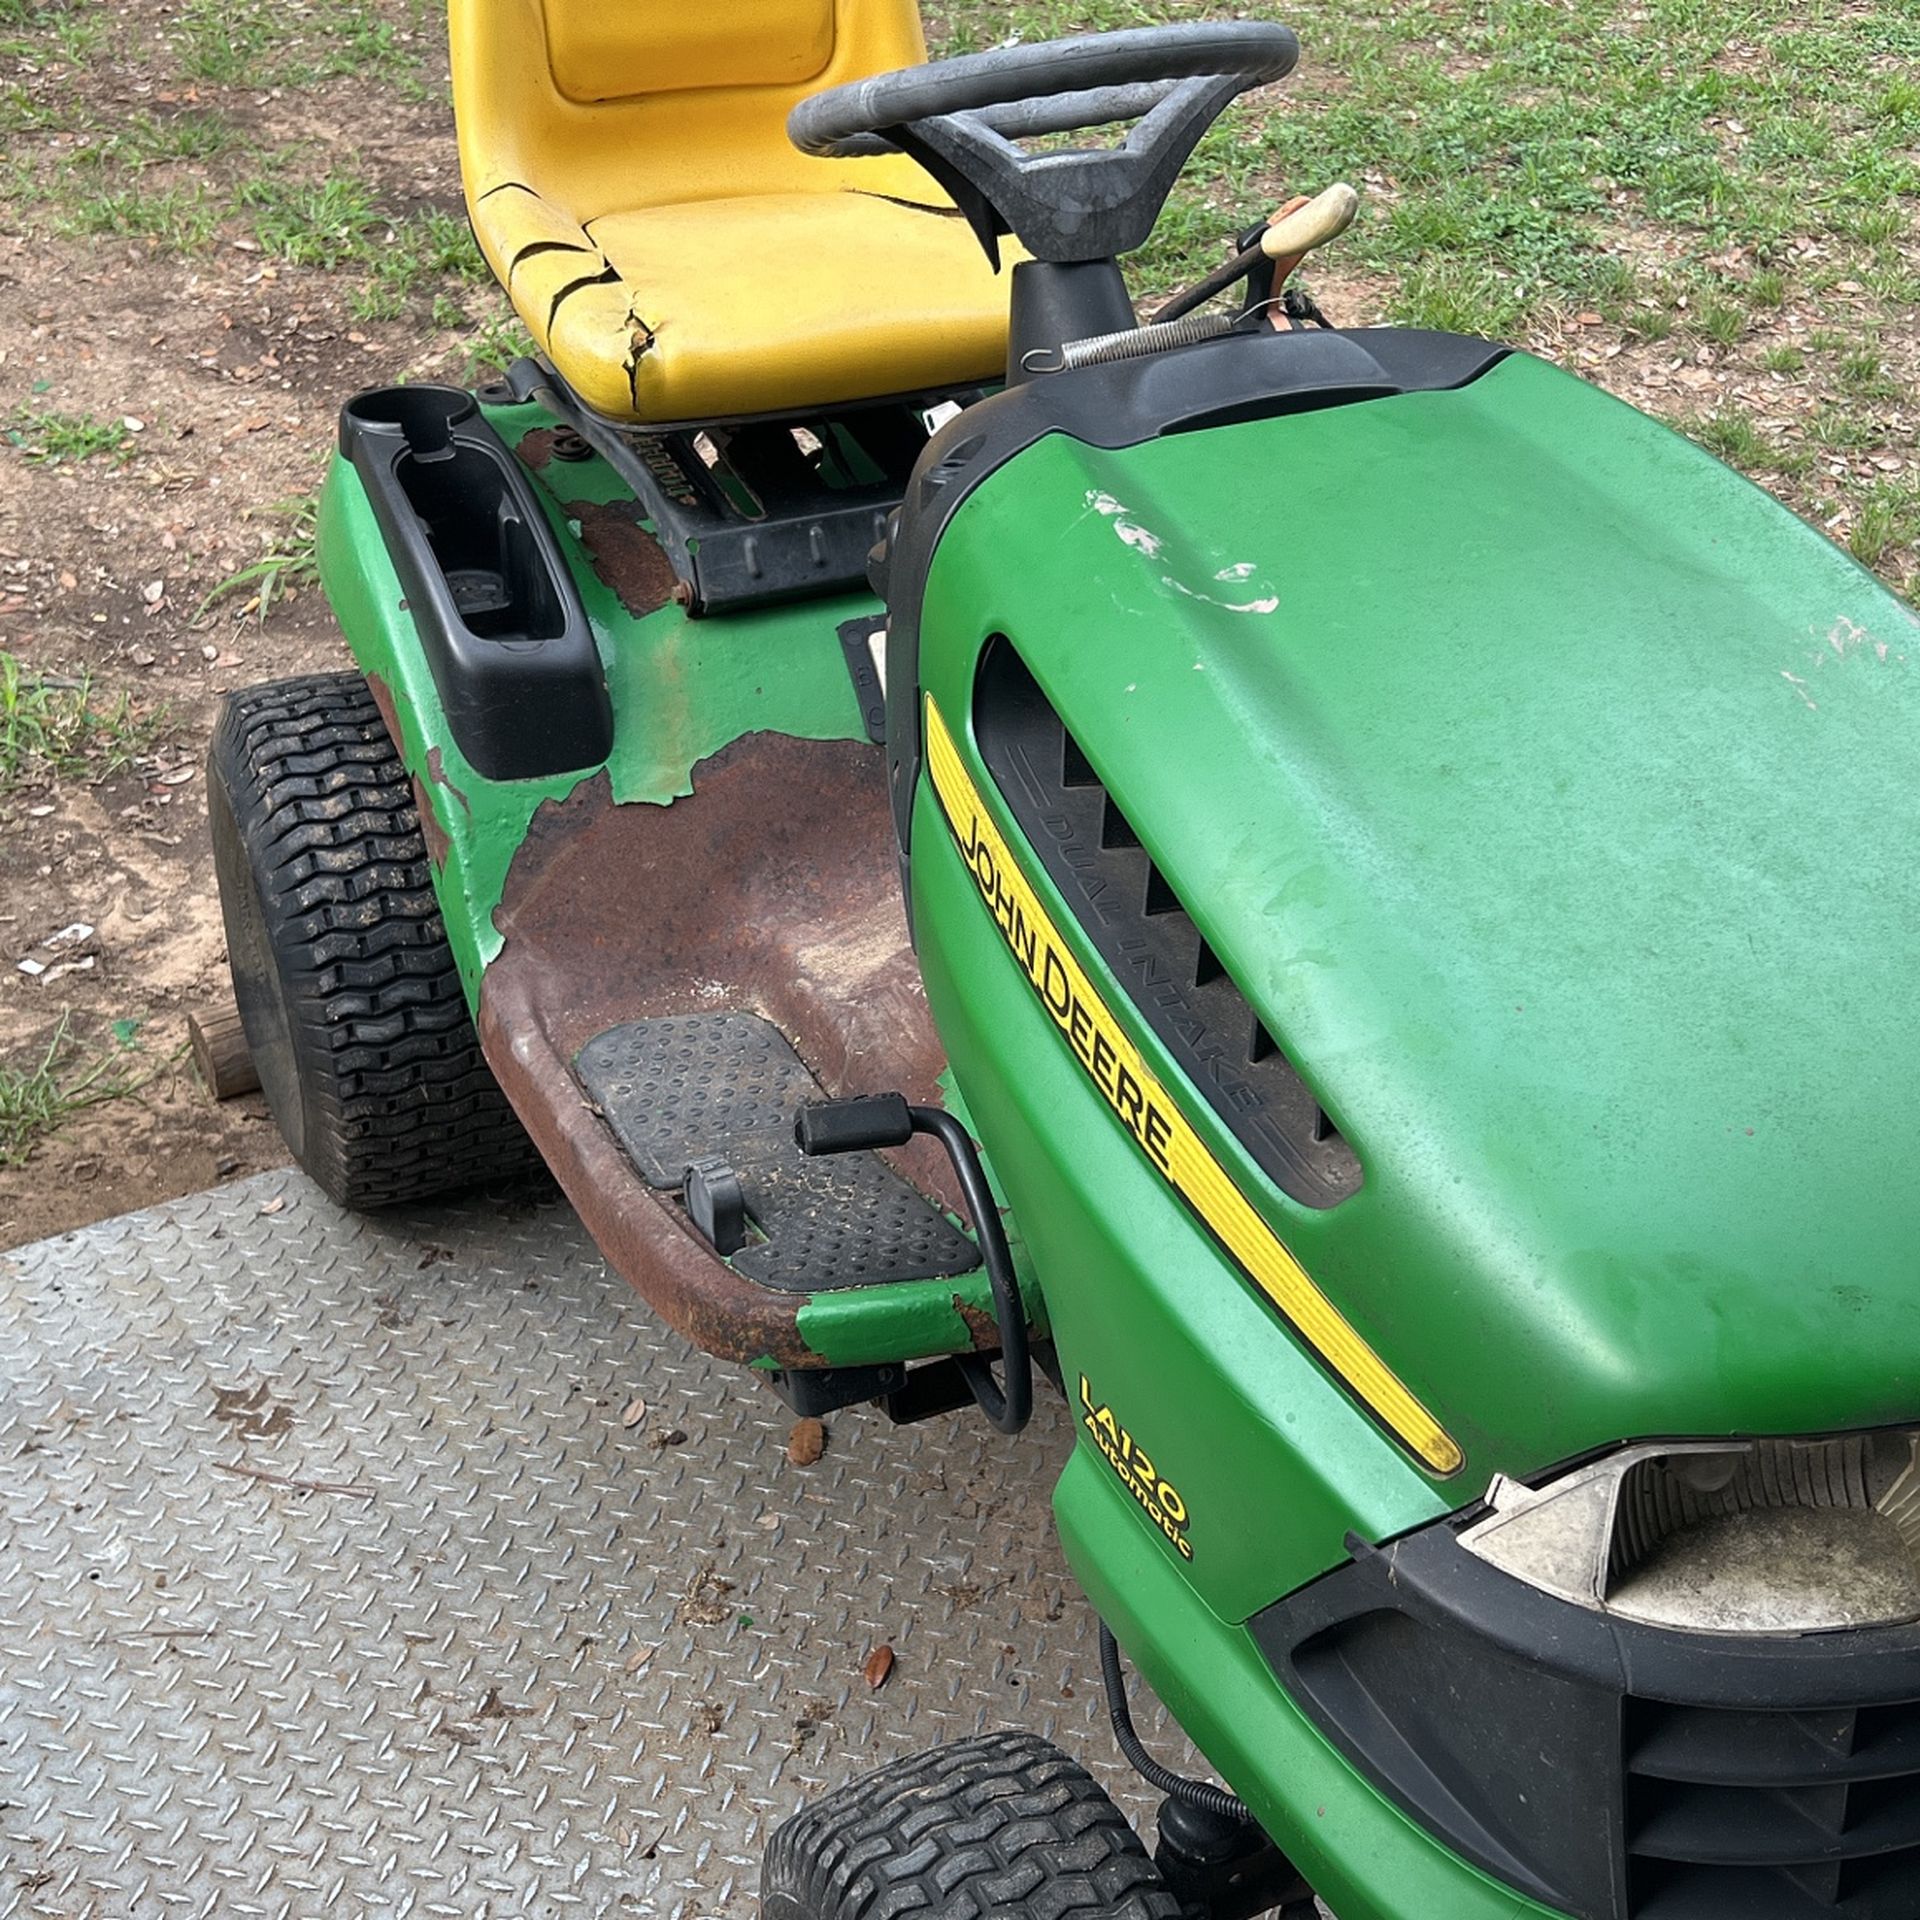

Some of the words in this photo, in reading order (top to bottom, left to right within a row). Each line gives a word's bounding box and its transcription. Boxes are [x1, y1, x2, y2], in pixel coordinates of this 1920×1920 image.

[961, 814, 1036, 974] JOHN
[1044, 944, 1172, 1170] DEERE
[1039, 815, 1124, 926] DUAL
[1116, 938, 1264, 1112] INTAKE
[1081, 1374, 1188, 1525] LA120
[1085, 1415, 1192, 1558] Automatic
